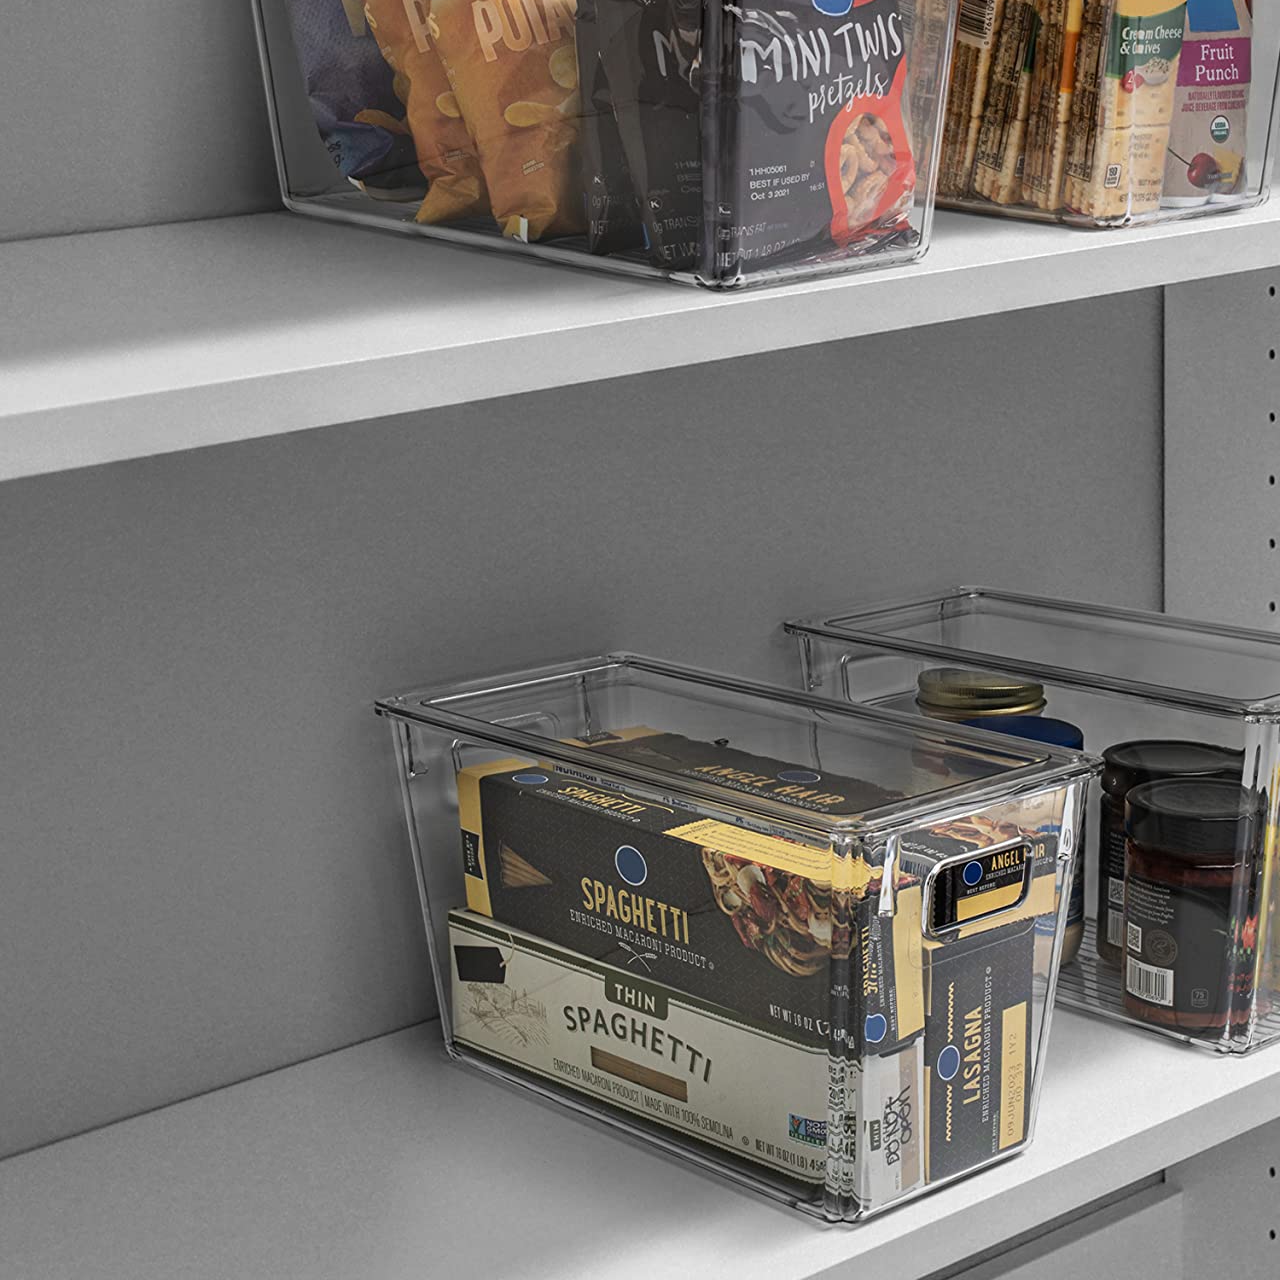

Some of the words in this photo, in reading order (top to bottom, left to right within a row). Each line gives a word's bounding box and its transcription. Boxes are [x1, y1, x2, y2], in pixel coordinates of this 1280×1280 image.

[739, 27, 831, 84] MINI
[833, 12, 902, 69] TWIS
[1154, 25, 1183, 40] Cheese
[1119, 43, 1130, 56] &
[1200, 43, 1235, 61] Fruit
[1195, 64, 1239, 82] Punch
[807, 63, 889, 124] pretzels
[749, 179, 771, 189] BEST
[772, 178, 780, 187] IF
[781, 174, 800, 186] USED
[801, 172, 810, 182] BY
[750, 192, 765, 201] Oct
[774, 189, 790, 198] 2021
[754, 222, 767, 233] FAT
[557, 786, 647, 814] SPAGHETTI
[693, 764, 777, 788] ANGEL
[773, 784, 846, 805] HAIR
[991, 850, 1020, 871] ANGEL
[580, 876, 689, 945] SPAGHETTI
[569, 908, 613, 935] ENRICHED
[615, 924, 662, 954] MACARONI
[664, 943, 708, 969] PRODUCT
[614, 983, 656, 1013] THIN
[984, 975, 993, 1020] PRODUCT
[1194, 991, 1205, 999] 75
[769, 1004, 781, 1019] NET
[782, 1009, 792, 1024] WT
[793, 1013, 802, 1027] 16
[803, 1018, 814, 1032] OZ
[563, 1005, 712, 1083] SPAGHETTI
[963, 1005, 983, 1105] LASAGNA
[983, 1021, 992, 1073] MACARONI
[1008, 1032, 1018, 1056] 1Y2
[552, 1057, 582, 1080] ENRICHED
[582, 1068, 612, 1094] MACARONI
[612, 1081, 640, 1104] PRODUCT
[644, 1094, 663, 1113] MADE
[663, 1101, 681, 1120] WITH
[681, 1108, 700, 1129] 100%
[701, 1115, 734, 1140] SEMOLINA
[982, 1074, 991, 1124] ENRICHED
[1007, 1065, 1017, 1137] 09JUN2023
[755, 1138, 765, 1153] NET
[765, 1143, 775, 1157] WT
[775, 1146, 783, 1160] 16
[782, 1148, 790, 1163] OZ
[796, 1154, 808, 1171] LB)
